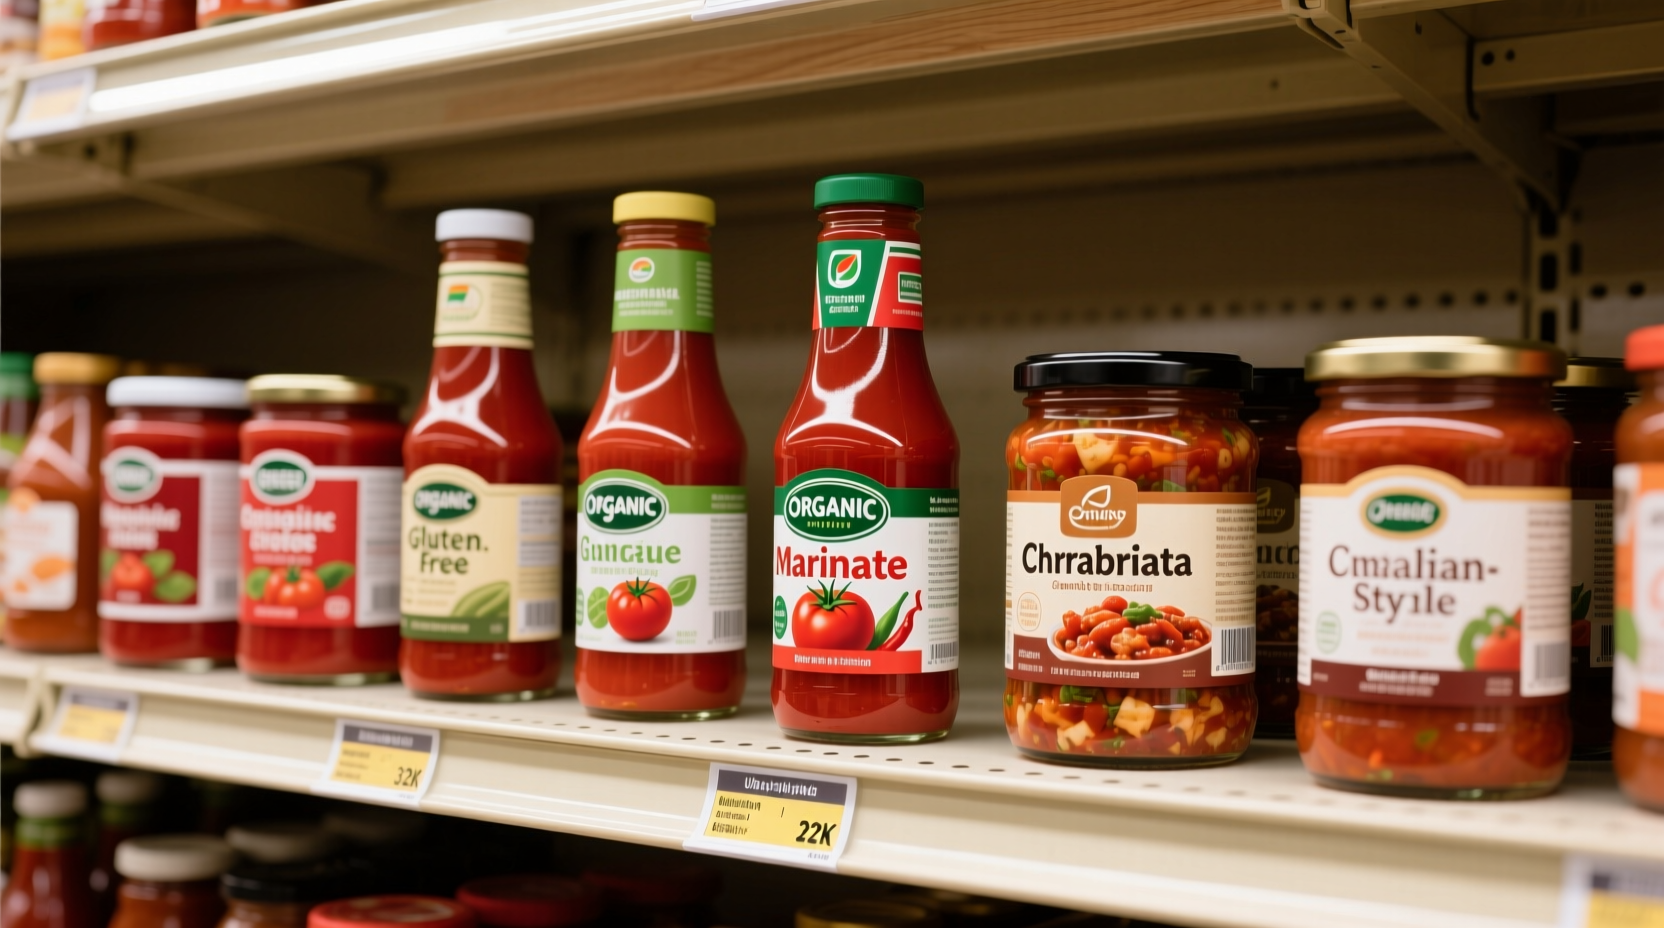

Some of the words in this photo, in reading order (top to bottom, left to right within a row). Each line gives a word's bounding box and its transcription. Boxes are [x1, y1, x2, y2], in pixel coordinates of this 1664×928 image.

[788, 495, 877, 521] ORGANIC
[421, 553, 468, 574] Free
[776, 546, 908, 580] Marinate
[1022, 542, 1193, 577] Chrrabriata
[796, 820, 837, 846] 22K
